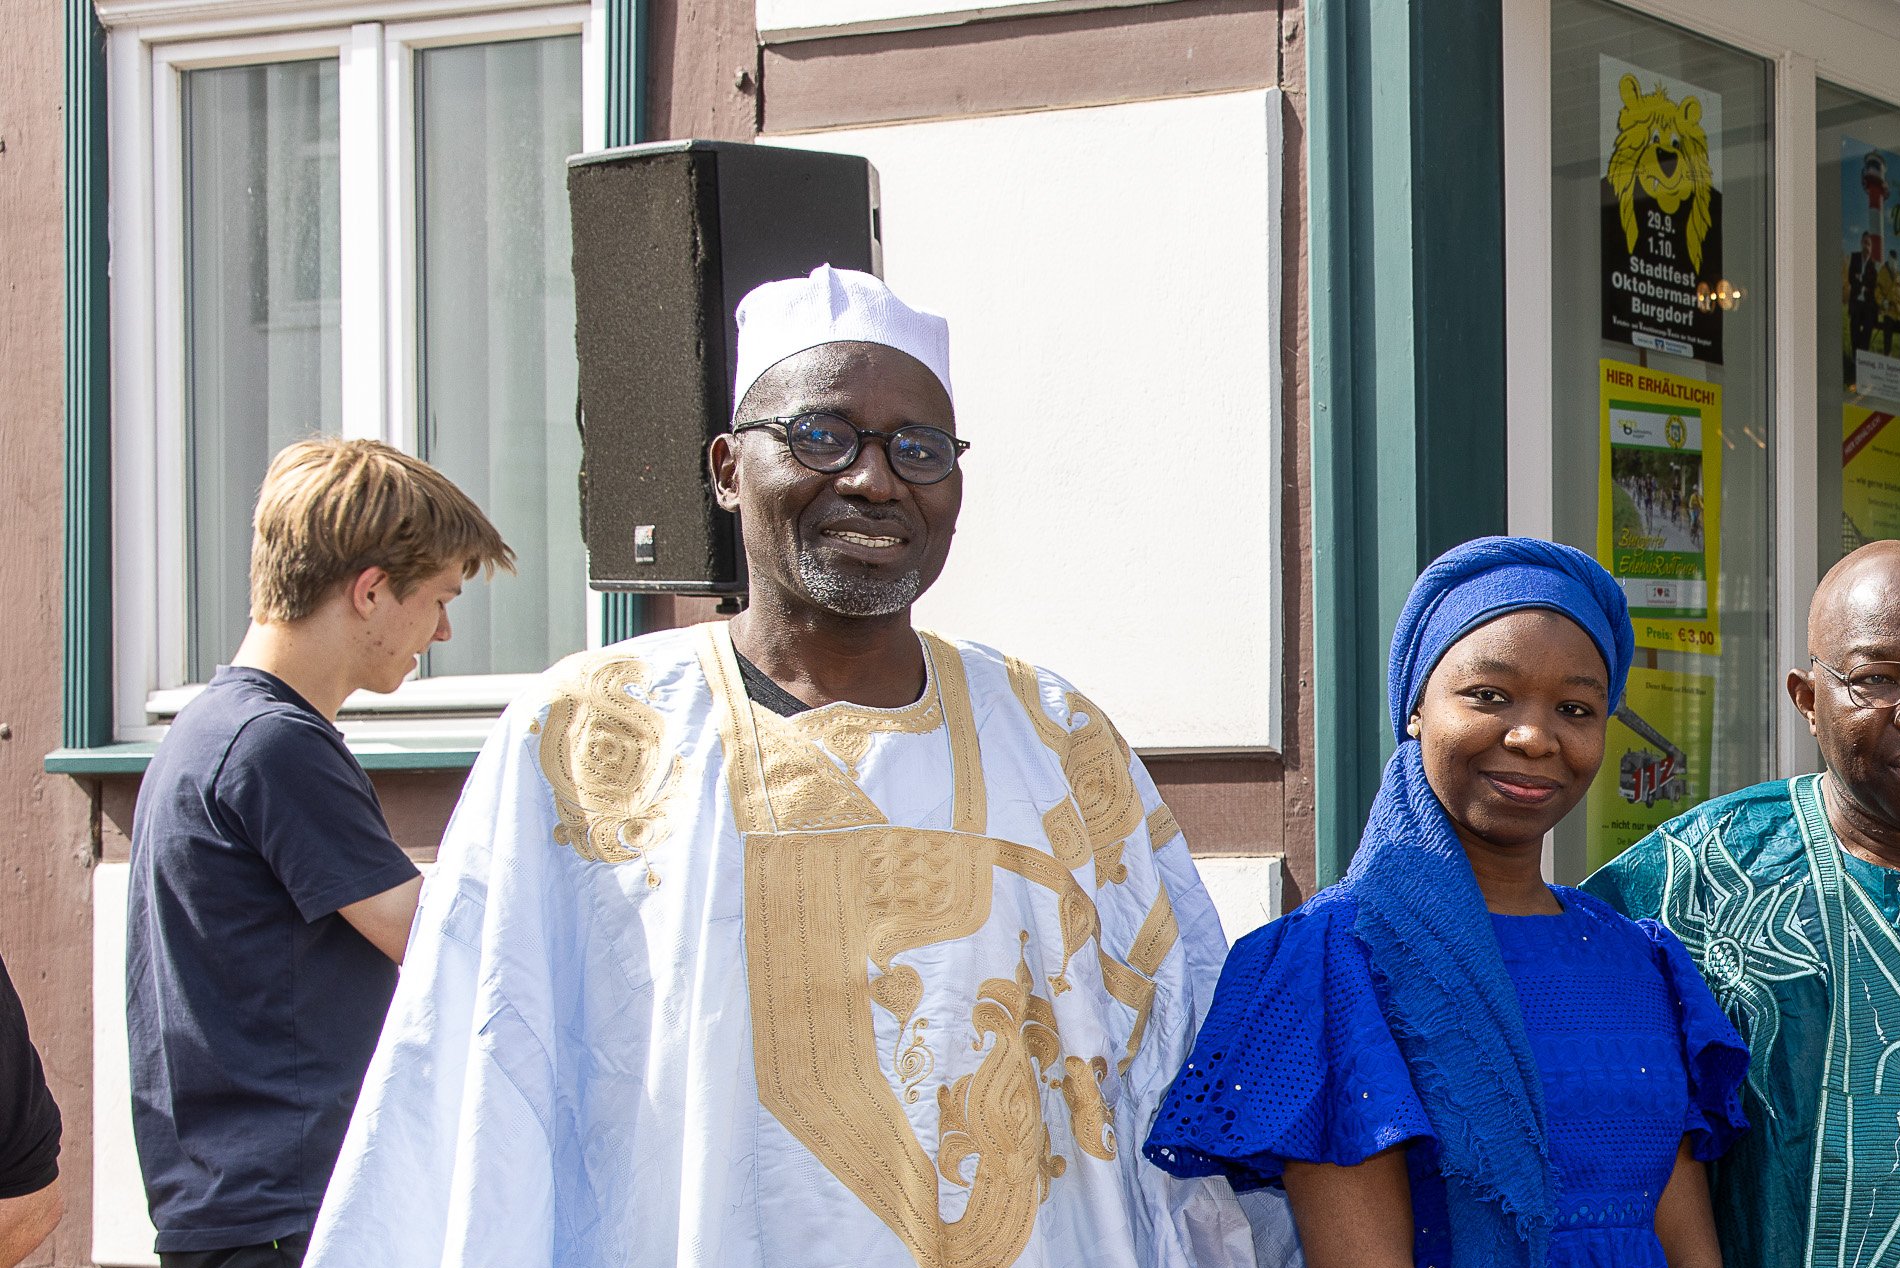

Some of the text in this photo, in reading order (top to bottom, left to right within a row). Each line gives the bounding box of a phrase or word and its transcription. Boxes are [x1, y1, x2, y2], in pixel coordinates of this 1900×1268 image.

[1647, 210, 1676, 234] 29.9.
[1648, 236, 1676, 259] 1.10.
[1629, 255, 1696, 288] Stadtfest
[1611, 271, 1712, 311] Oktobermarkt
[1631, 297, 1694, 327] Burgdorf
[1606, 368, 1715, 406] HIER ERHÄLTLICH!
[1646, 626, 1673, 640] Preis:
[1631, 754, 1677, 804] 112
[1611, 819, 1630, 831] nicht
[1632, 822, 1645, 831] nur
